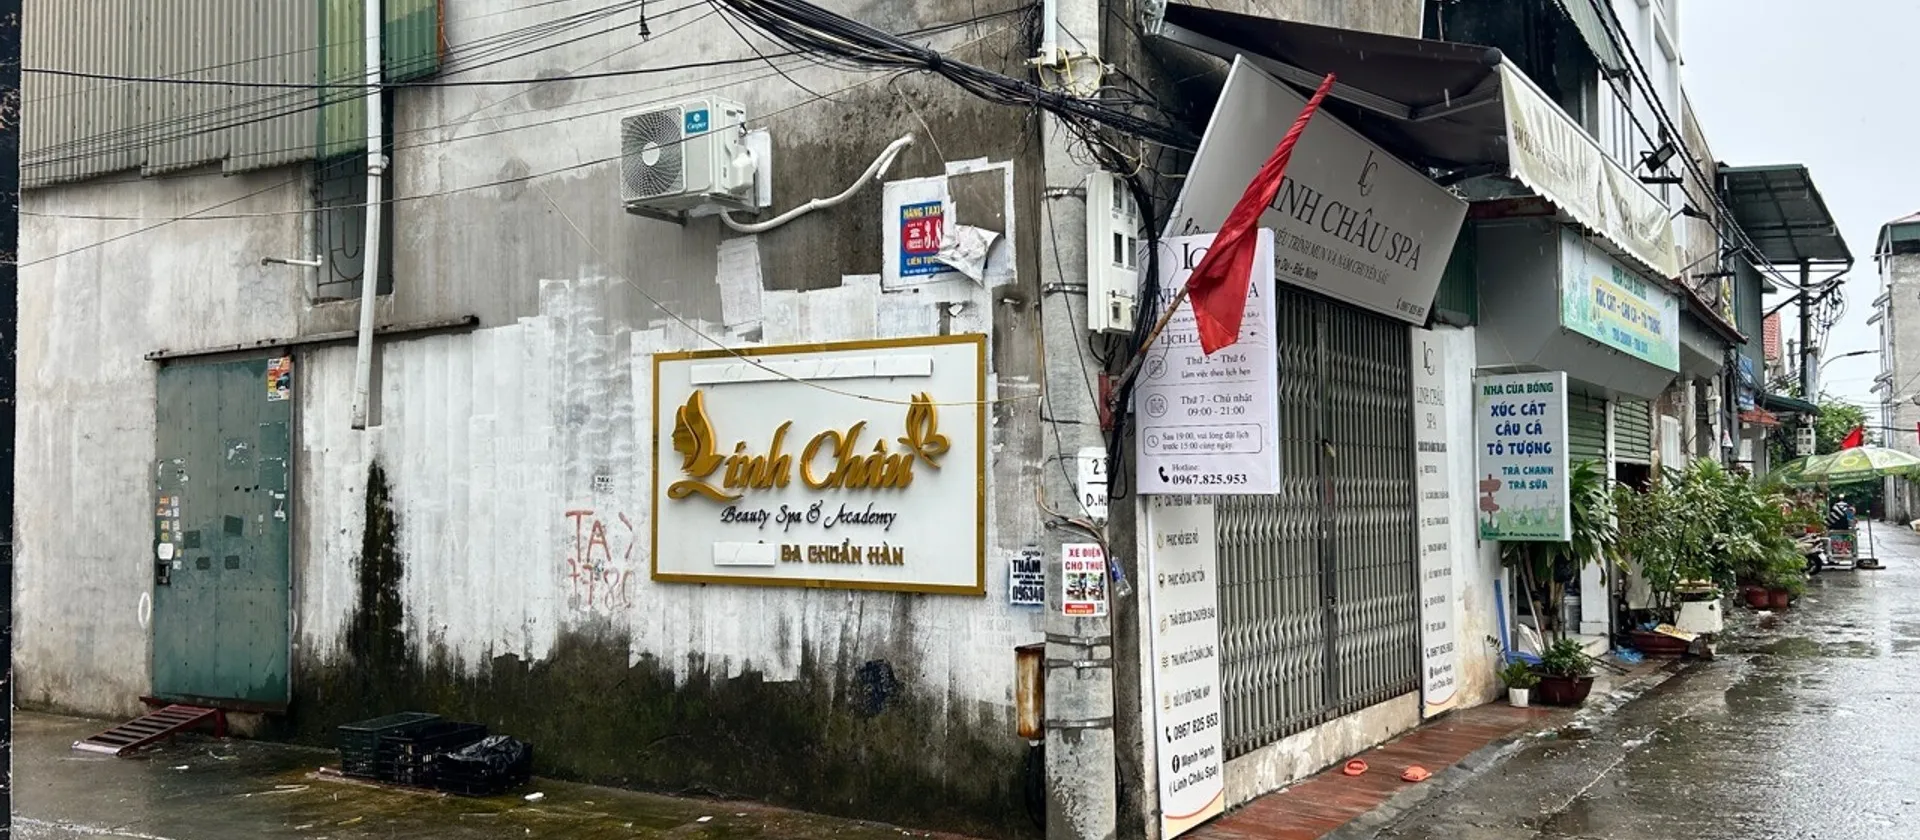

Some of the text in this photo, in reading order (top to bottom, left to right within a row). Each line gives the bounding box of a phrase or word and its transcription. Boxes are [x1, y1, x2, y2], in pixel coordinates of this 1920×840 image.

[1321, 200, 1389, 253] CHÂU
[1385, 231, 1422, 271] SPA
[1240, 352, 1247, 362] 6
[1483, 381, 1504, 395] NHÀ
[1506, 381, 1525, 394] CỦA
[1199, 394, 1205, 404] 7
[1187, 407, 1212, 416] 09:00
[1220, 405, 1245, 415] 21:00
[1491, 399, 1546, 417] XÚC CÁT
[1495, 419, 1543, 436] CÂU CÁ
[800, 420, 915, 490] Châu
[1487, 440, 1552, 458] TÔ TƯỢNG
[1502, 464, 1554, 475] TRÀ CHANH
[1172, 473, 1248, 485] 0967.825.953
[1508, 478, 1548, 490] TRÀ SỮA
[720, 499, 897, 532] Beauty Spa & Academy
[807, 537, 863, 565] CHUẨN
[867, 541, 904, 566] HÀN
[1069, 548, 1080, 557] XE
[1065, 561, 1083, 570] CHO
[1174, 712, 1219, 741] 0967 825 953
